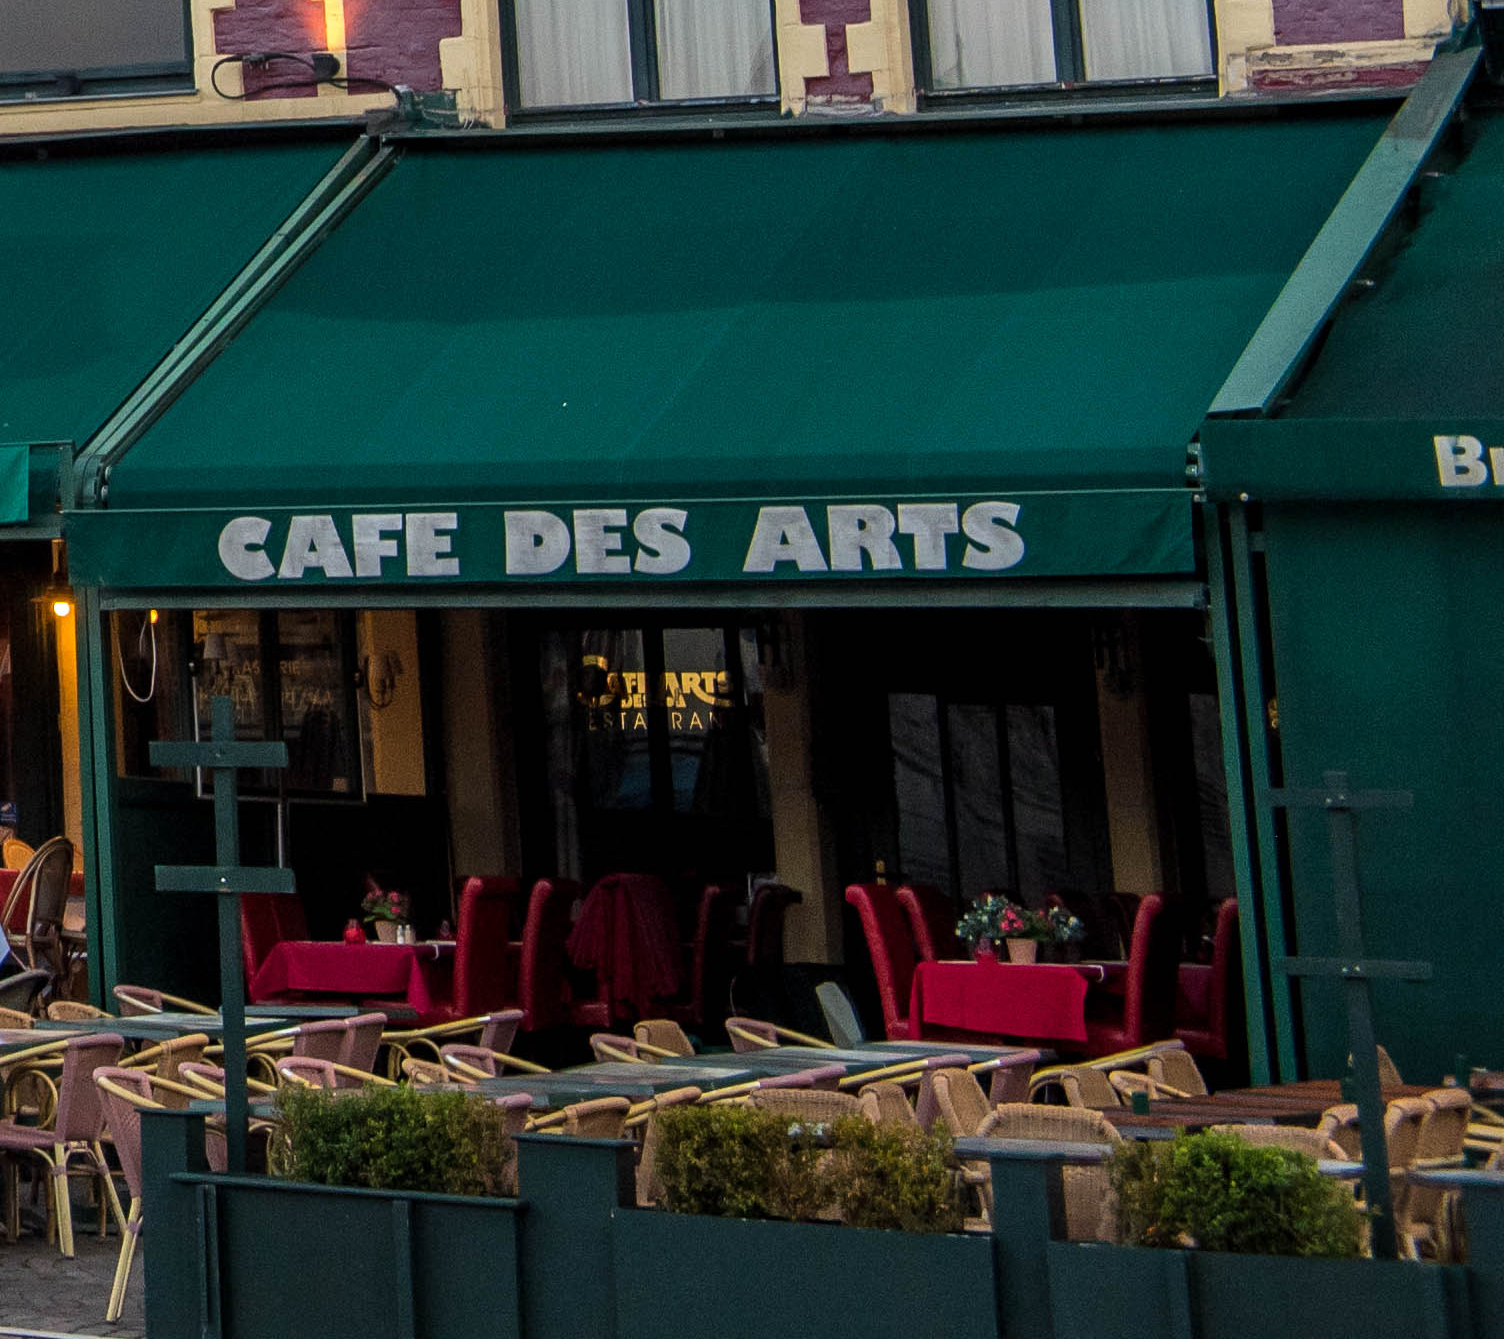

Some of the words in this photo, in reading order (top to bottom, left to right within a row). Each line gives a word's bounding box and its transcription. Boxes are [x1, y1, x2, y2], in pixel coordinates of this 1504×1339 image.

[217, 512, 460, 581] CAFE
[503, 506, 691, 575] DES
[742, 500, 1025, 573] ARTS
